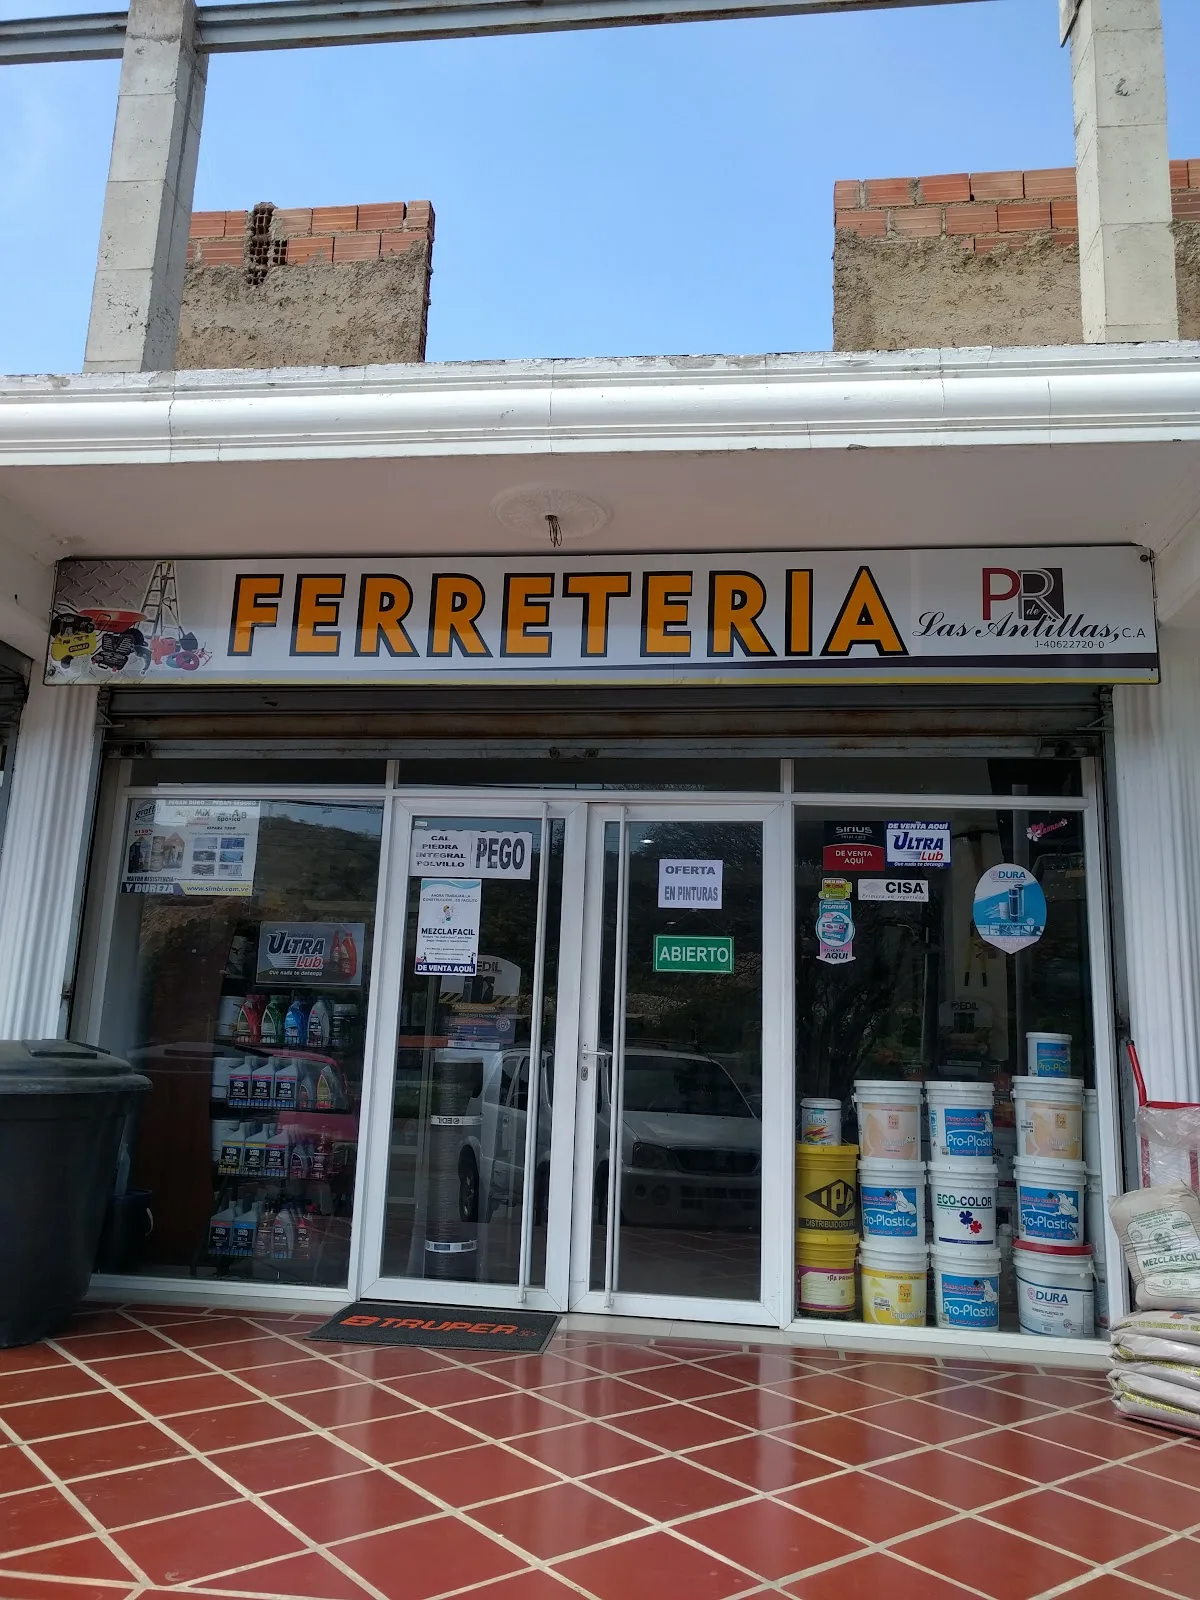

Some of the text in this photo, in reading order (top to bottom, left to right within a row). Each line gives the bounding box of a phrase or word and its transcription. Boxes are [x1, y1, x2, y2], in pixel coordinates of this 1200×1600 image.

[227, 565, 910, 658] FERRETERIA
[1025, 604, 1041, 616] de
[912, 610, 976, 638] Las
[1034, 640, 1105, 650] J-40622720-0
[892, 831, 944, 850] ULTRA
[475, 837, 525, 870] PEGO
[921, 851, 944, 861] Lub
[417, 860, 465, 868] POLVILLO
[844, 857, 864, 865] AQUÍ
[665, 865, 716, 875] OFERTA
[998, 870, 1026, 879] DURA
[135, 883, 174, 893] DUREZA
[664, 885, 718, 902] EN PINTURAS
[885, 881, 924, 894] CISA
[421, 927, 475, 936] MEZCLAFACIL
[659, 945, 729, 963] ABIERTO
[417, 964, 428, 972] DE
[428, 964, 453, 973] VENTA
[821, 1181, 854, 1211] IPA
[937, 1193, 992, 1207] ECO-COLOR
[1021, 1212, 1073, 1230] Pro-Plastic
[1142, 1252, 1200, 1268] MEZCLAFACIL
[1035, 1290, 1069, 1304] DURA
[943, 1300, 995, 1317] Pro-Plastic
[378, 1316, 519, 1336] TRUPER
